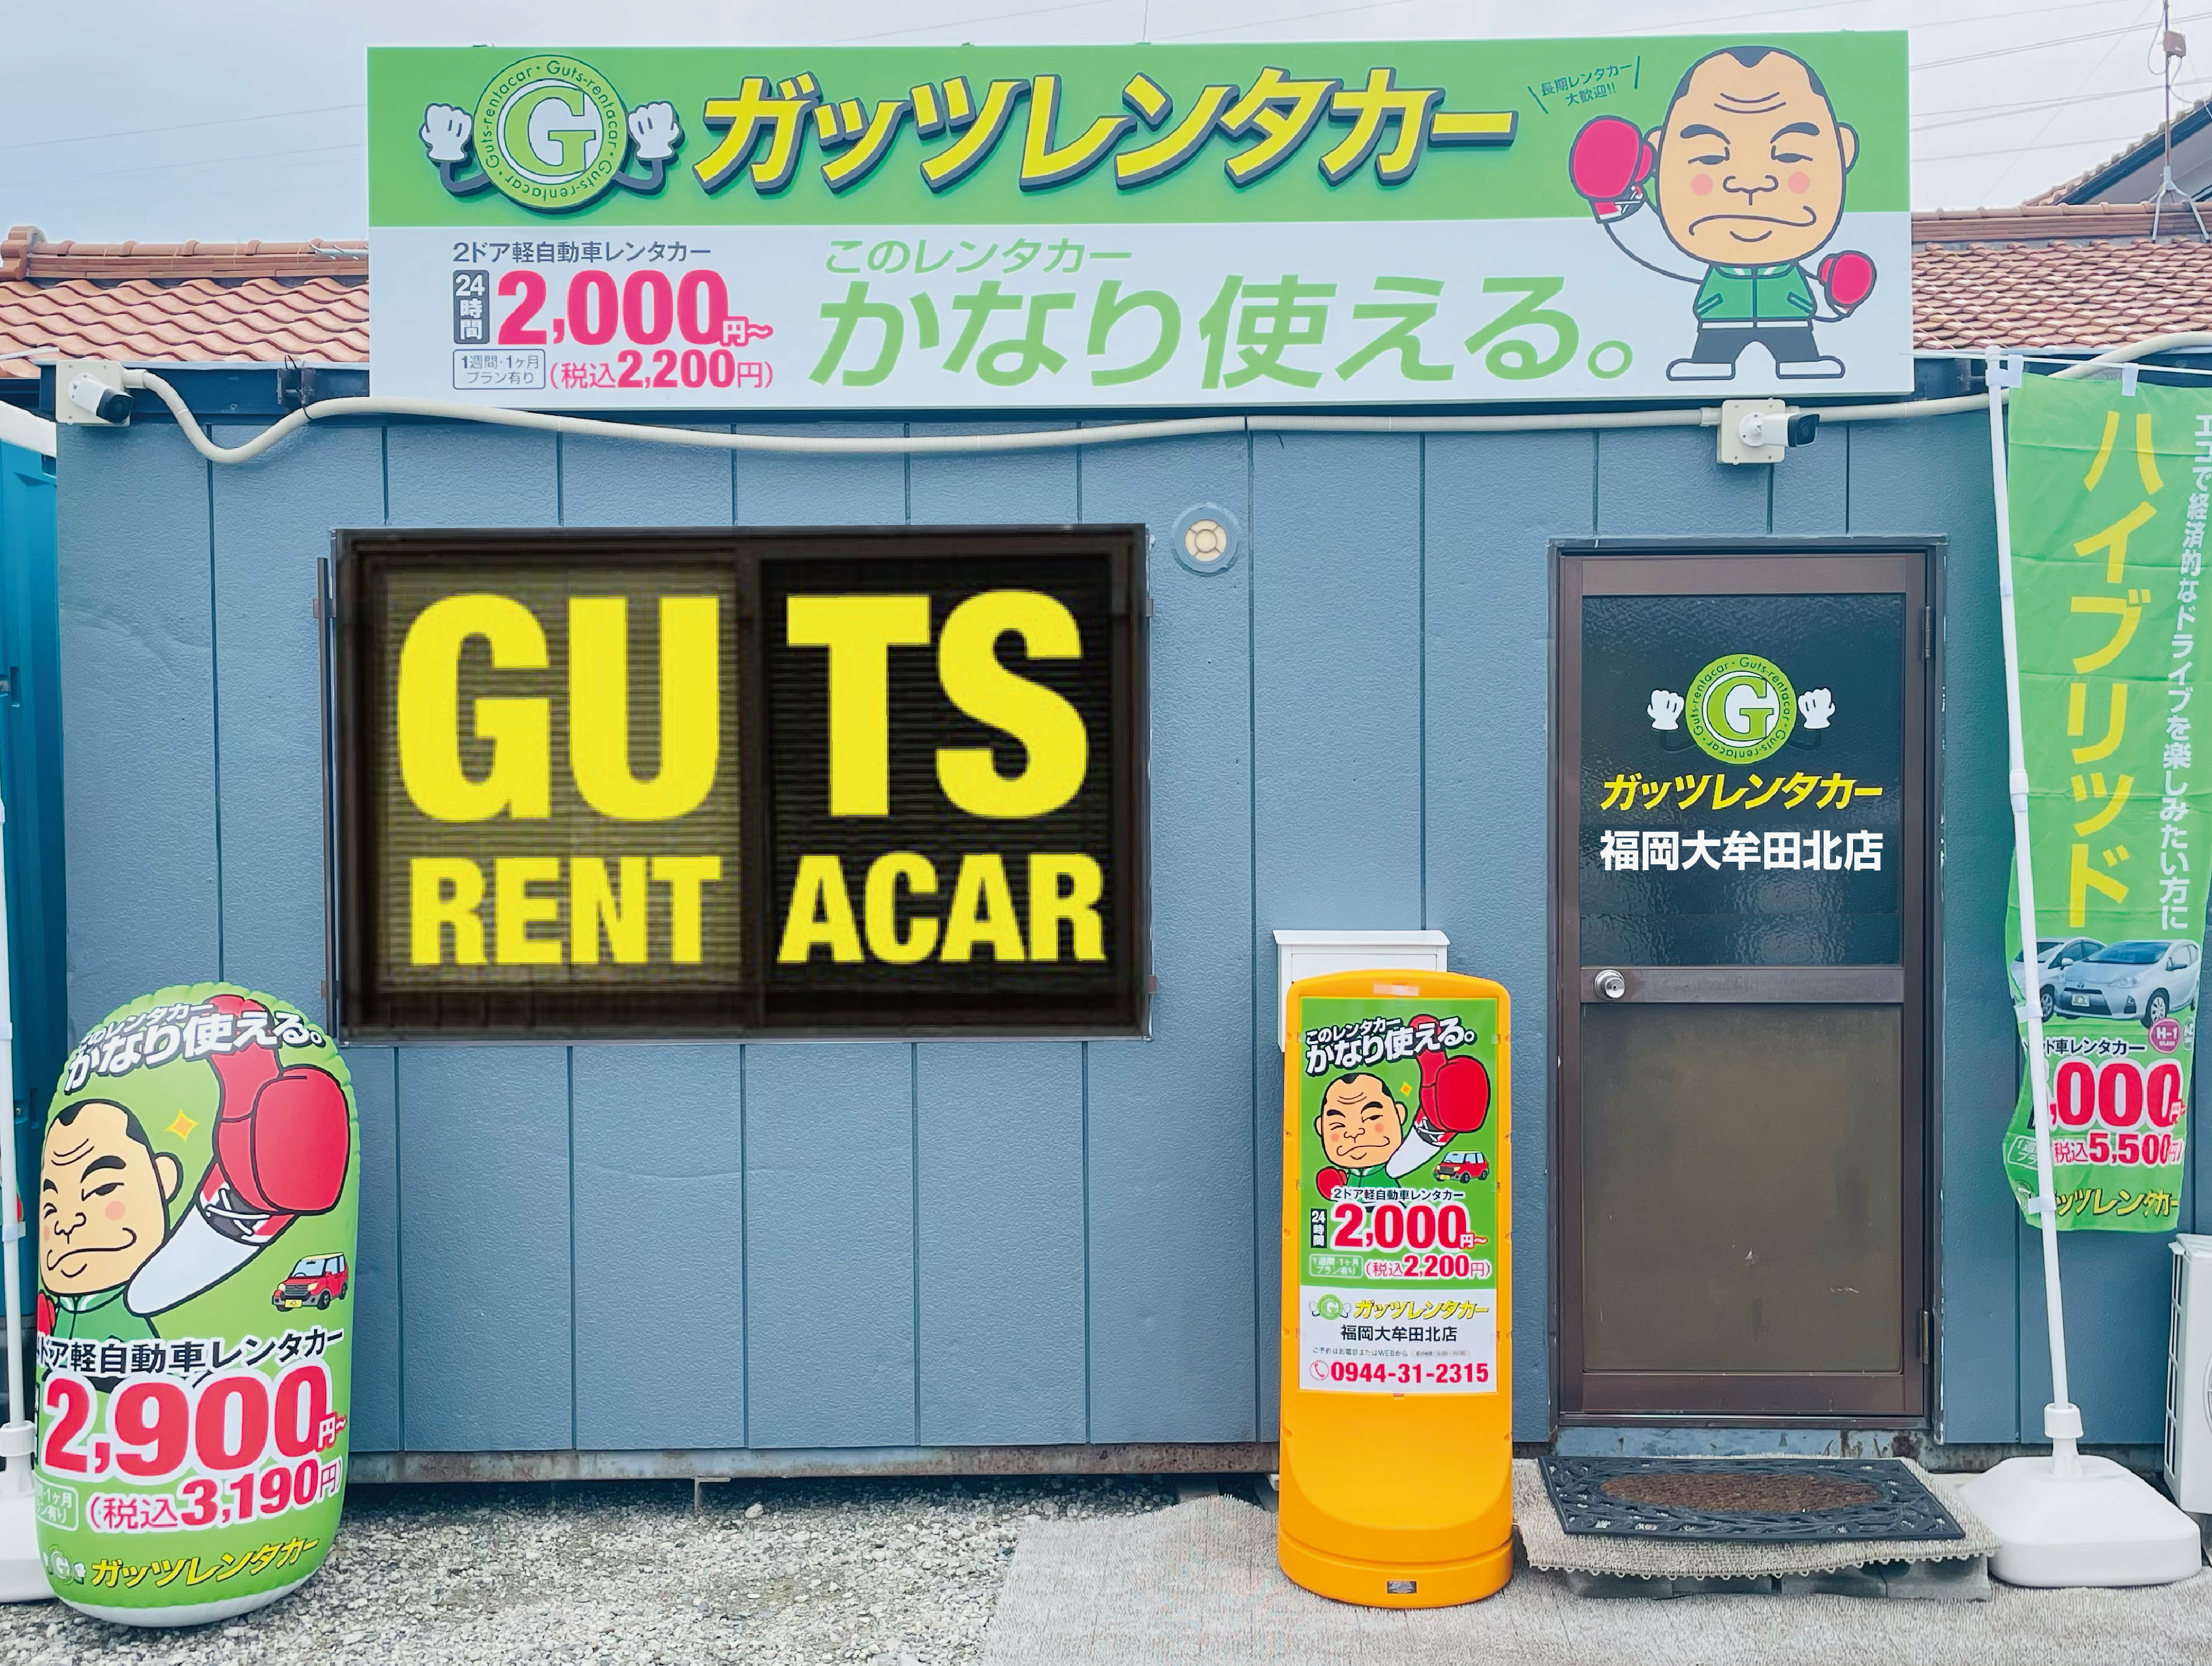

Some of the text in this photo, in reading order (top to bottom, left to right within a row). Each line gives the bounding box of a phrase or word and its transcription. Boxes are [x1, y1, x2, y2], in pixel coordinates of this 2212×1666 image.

[1541, 64, 1632, 96] 長期レンタカー
[504, 86, 597, 177] G
[693, 66, 1518, 194] ガッツレンタカー
[453, 241, 711, 263] 2ドア軽自動車レンタカー
[825, 238, 1133, 274] このレンタカー
[807, 274, 1633, 390] かなり使える。
[467, 370, 534, 385] プラン有り
[2068, 411, 2164, 928] ハイブリッド
[2159, 415, 2212, 930] エコで経済的なドライブを楽しみたい方に
[1707, 675, 1774, 742] G
[1600, 771, 1883, 811] ガッツレンタカー
[1600, 830, 1883, 872] 福岡大牟田北店
[78, 1003, 214, 1052] このレンタカー
[1305, 1016, 1476, 1075] かなり使える。
[1306, 1016, 1402, 1045] このレンタカー
[2156, 1026, 2178, 1039] H-1
[65, 1011, 324, 1092] かなり使える。
[1333, 1189, 1465, 1201] 2ドア軽自動車レンタカー
[2055, 1188, 2179, 1217] ッツレンタカー
[1353, 1300, 1489, 1319] ガッツレンタカー
[1341, 1325, 1457, 1342] 福岡大牟田北店
[1331, 1361, 1489, 1383] 0944-31-2315
[91, 1536, 319, 1588] ガッツレンタカー
